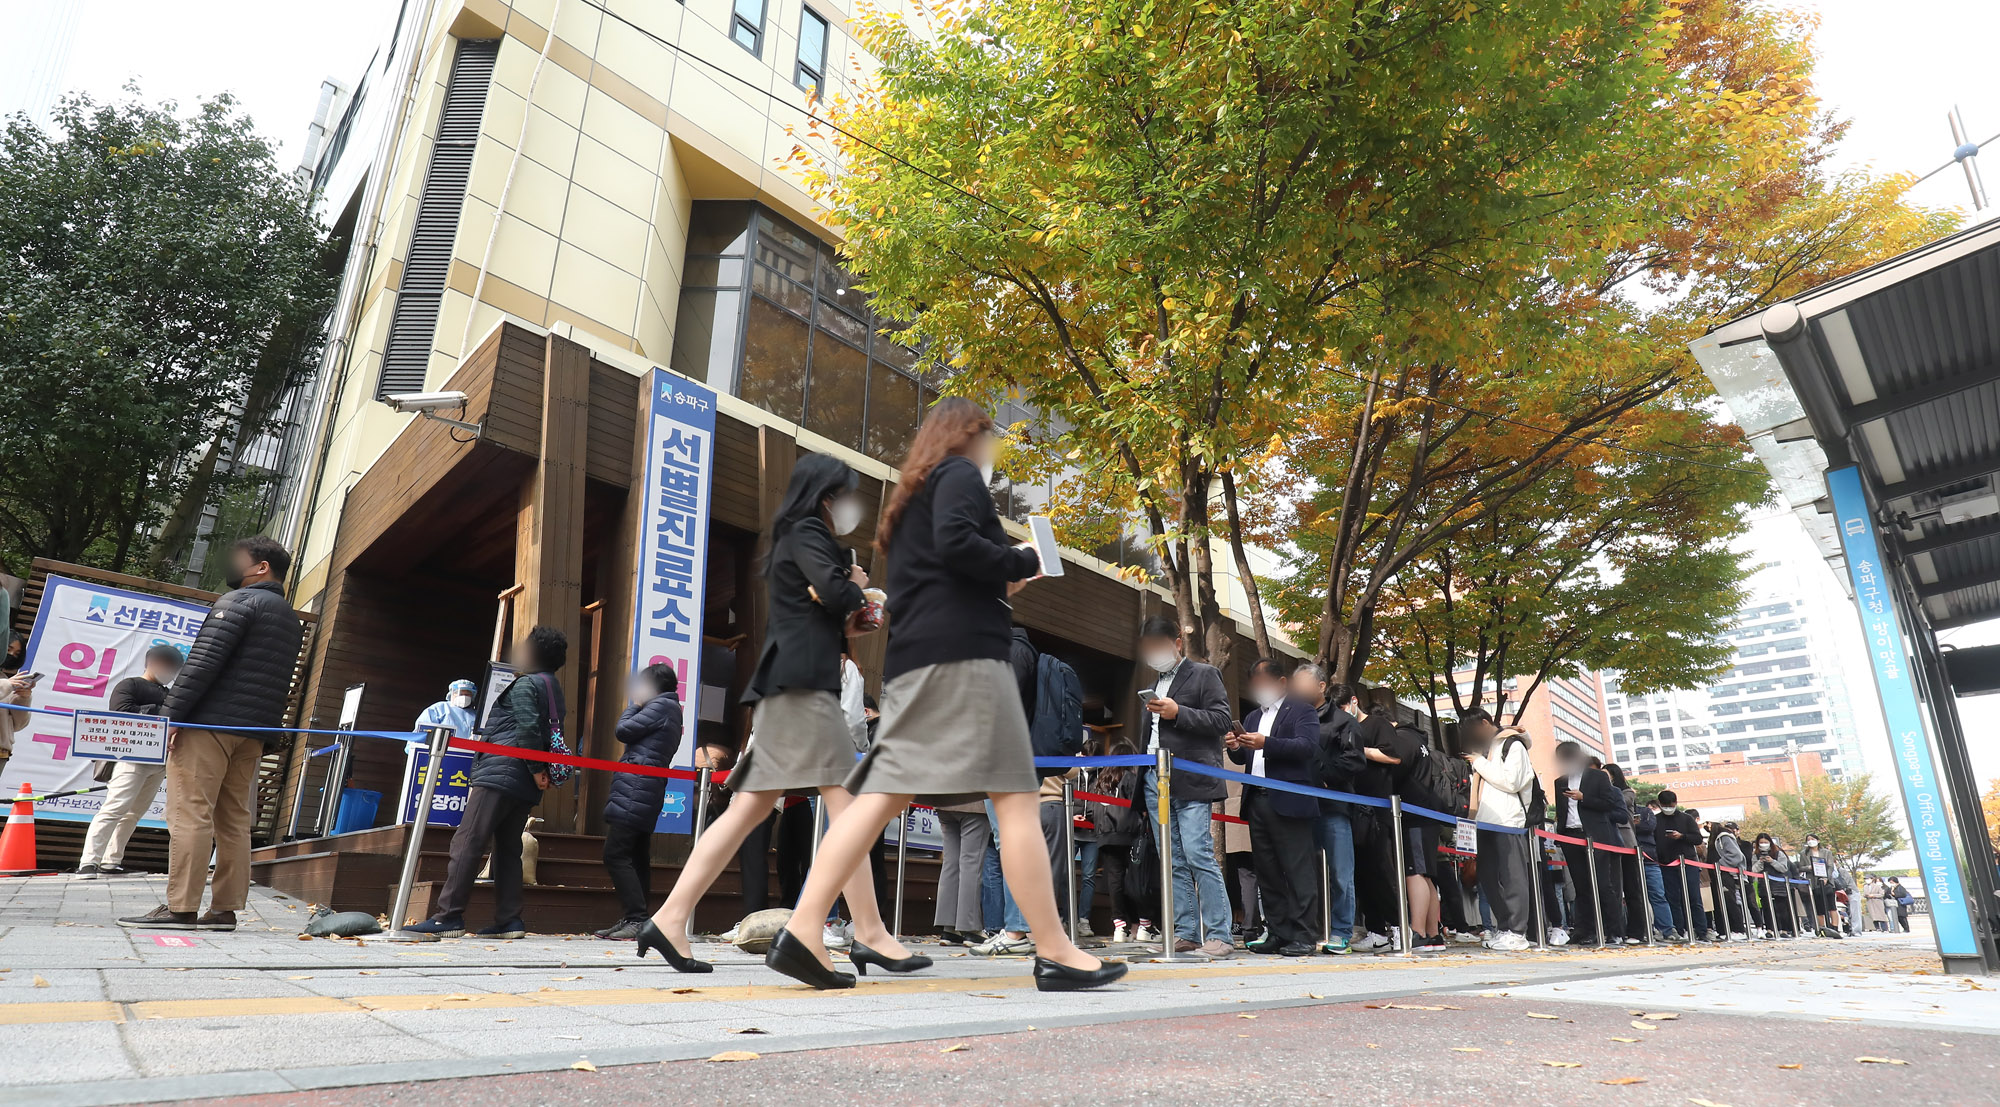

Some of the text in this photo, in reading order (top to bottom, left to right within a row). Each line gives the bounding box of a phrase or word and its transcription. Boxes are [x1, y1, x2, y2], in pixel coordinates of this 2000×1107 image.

[673, 391, 709, 412] 송파구
[650, 427, 701, 643] 선별진료소
[1901, 730, 1926, 789] Songpa-gu
[414, 792, 468, 812] 장하
[921, 816, 933, 835] 안
[1925, 830, 1947, 862] Bangi
[1932, 866, 1956, 905] Matgol
